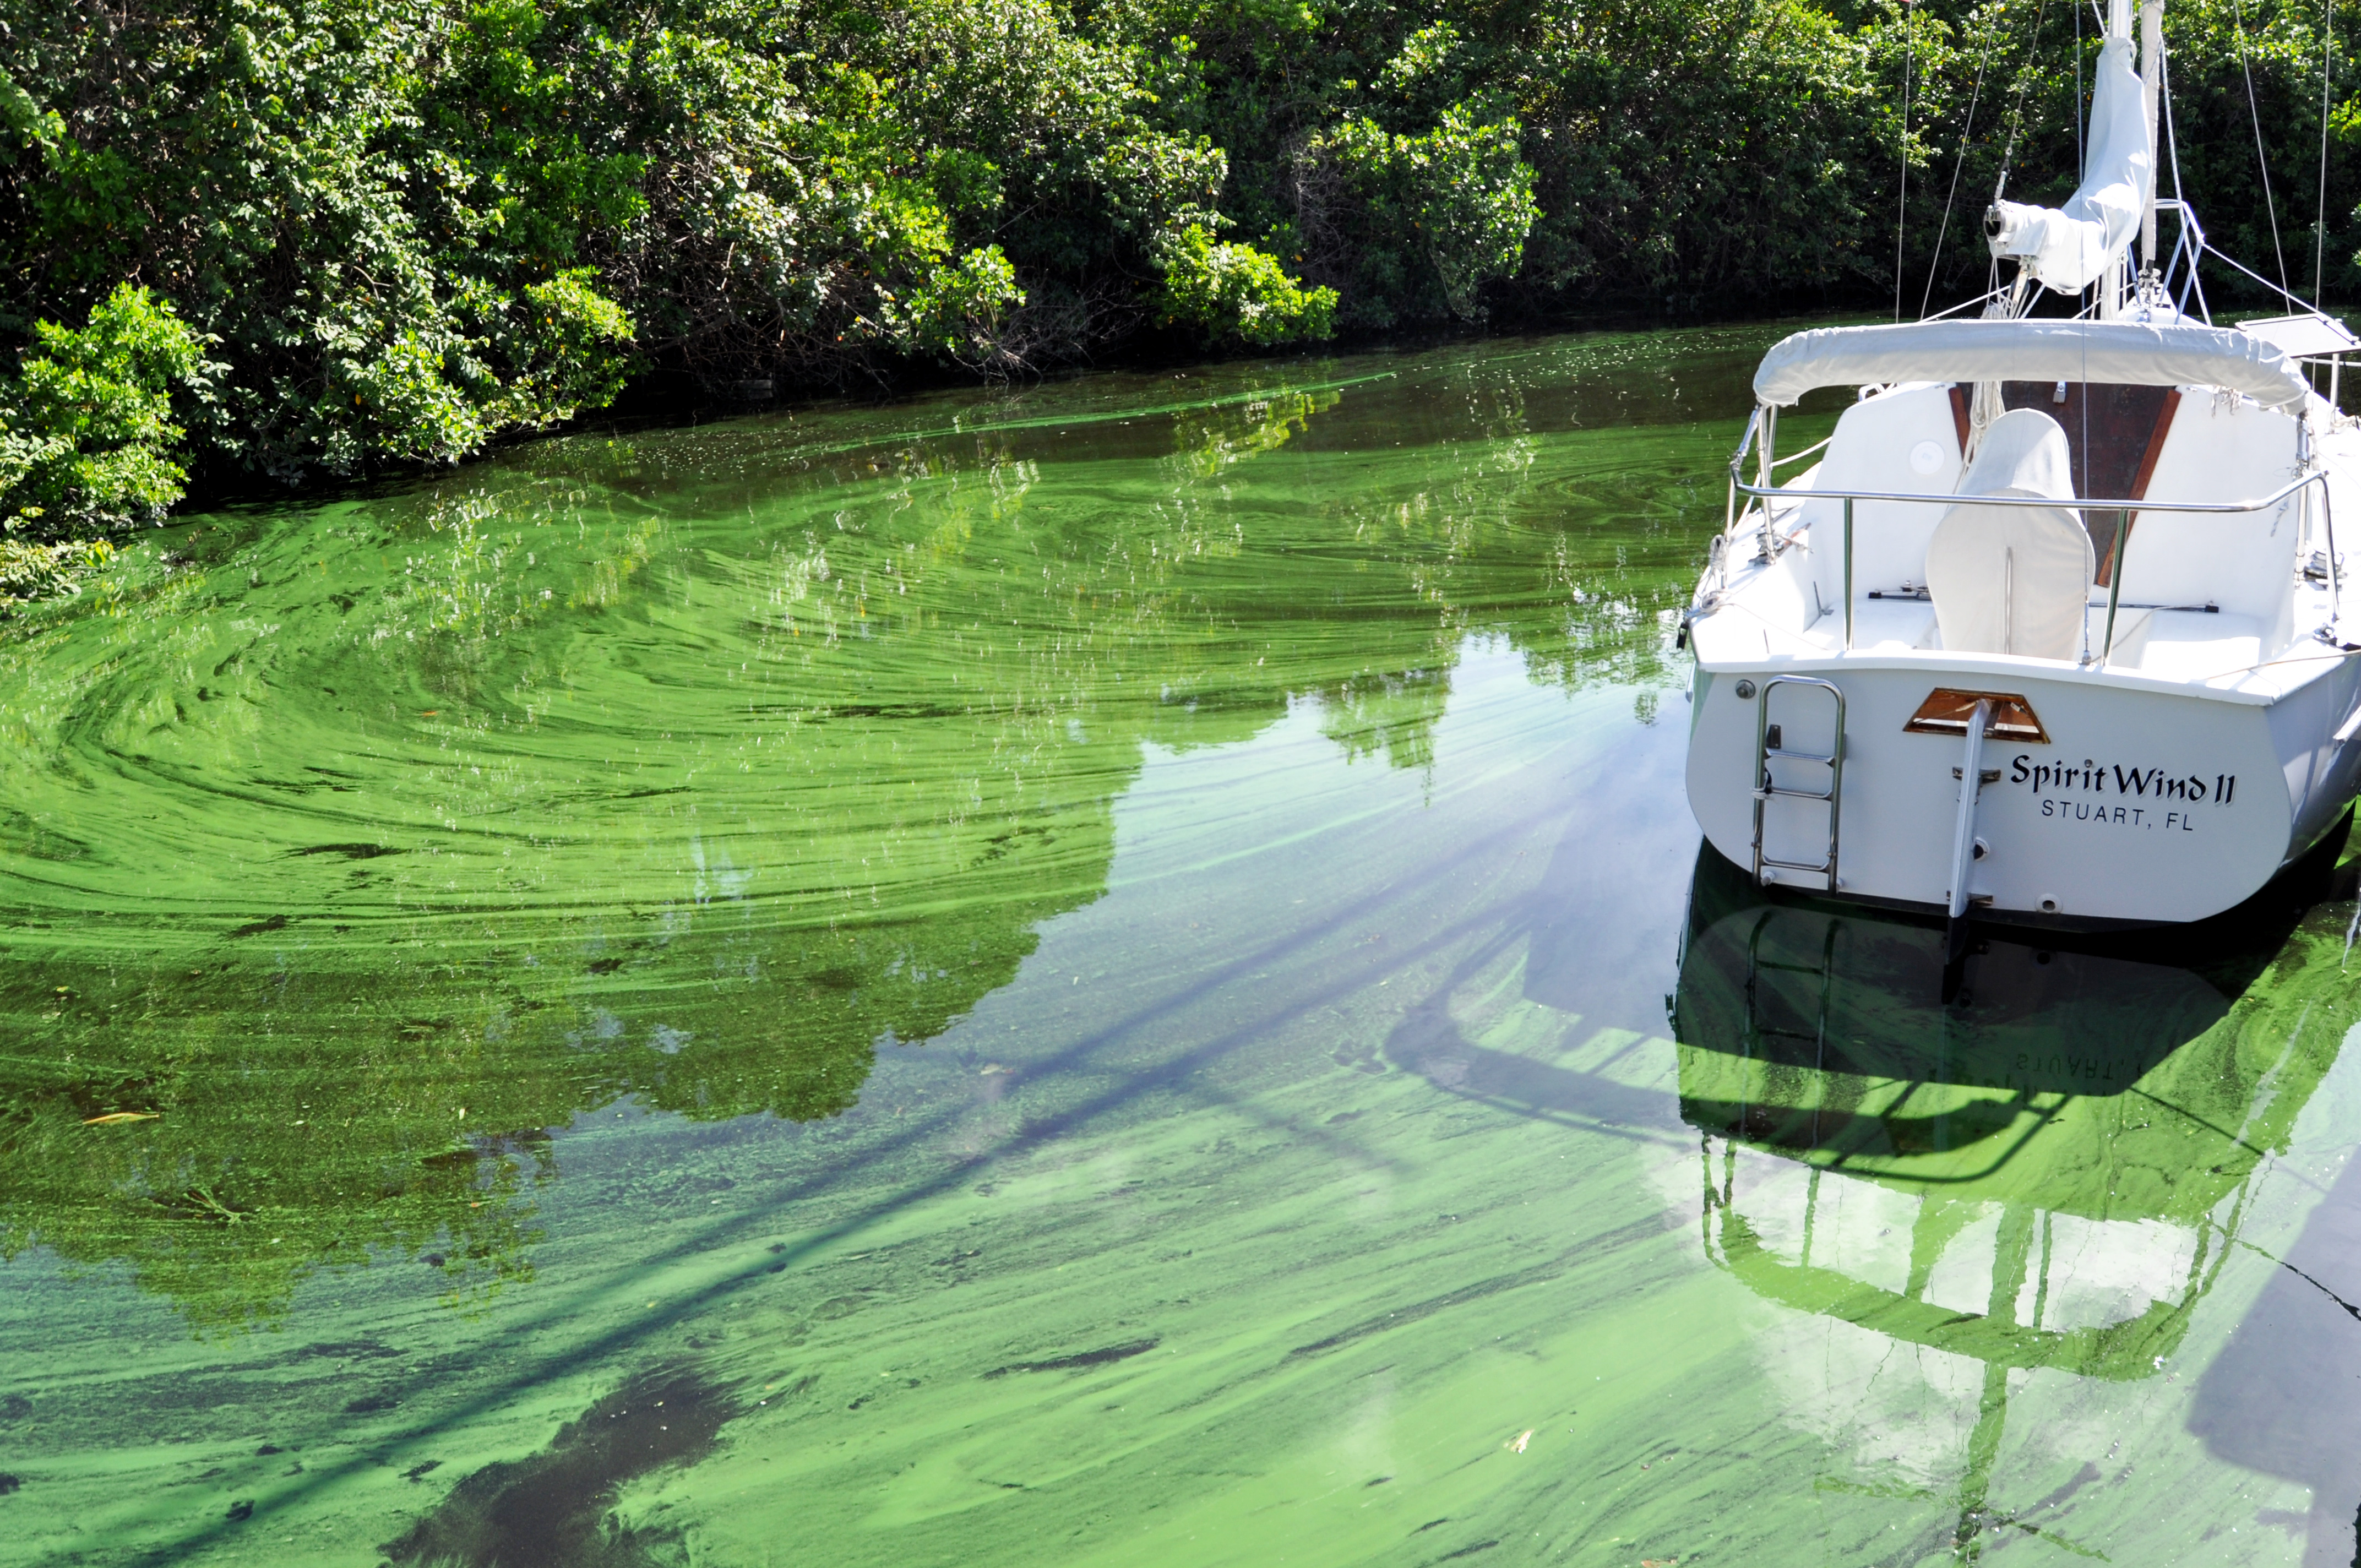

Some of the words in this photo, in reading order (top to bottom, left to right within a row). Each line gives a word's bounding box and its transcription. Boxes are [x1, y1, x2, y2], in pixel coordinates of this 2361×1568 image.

[2010, 754, 2107, 794] Spirit
[2112, 763, 2207, 802] Wind
[2041, 799, 2152, 830] STUART,
[2166, 812, 2194, 832] FL
